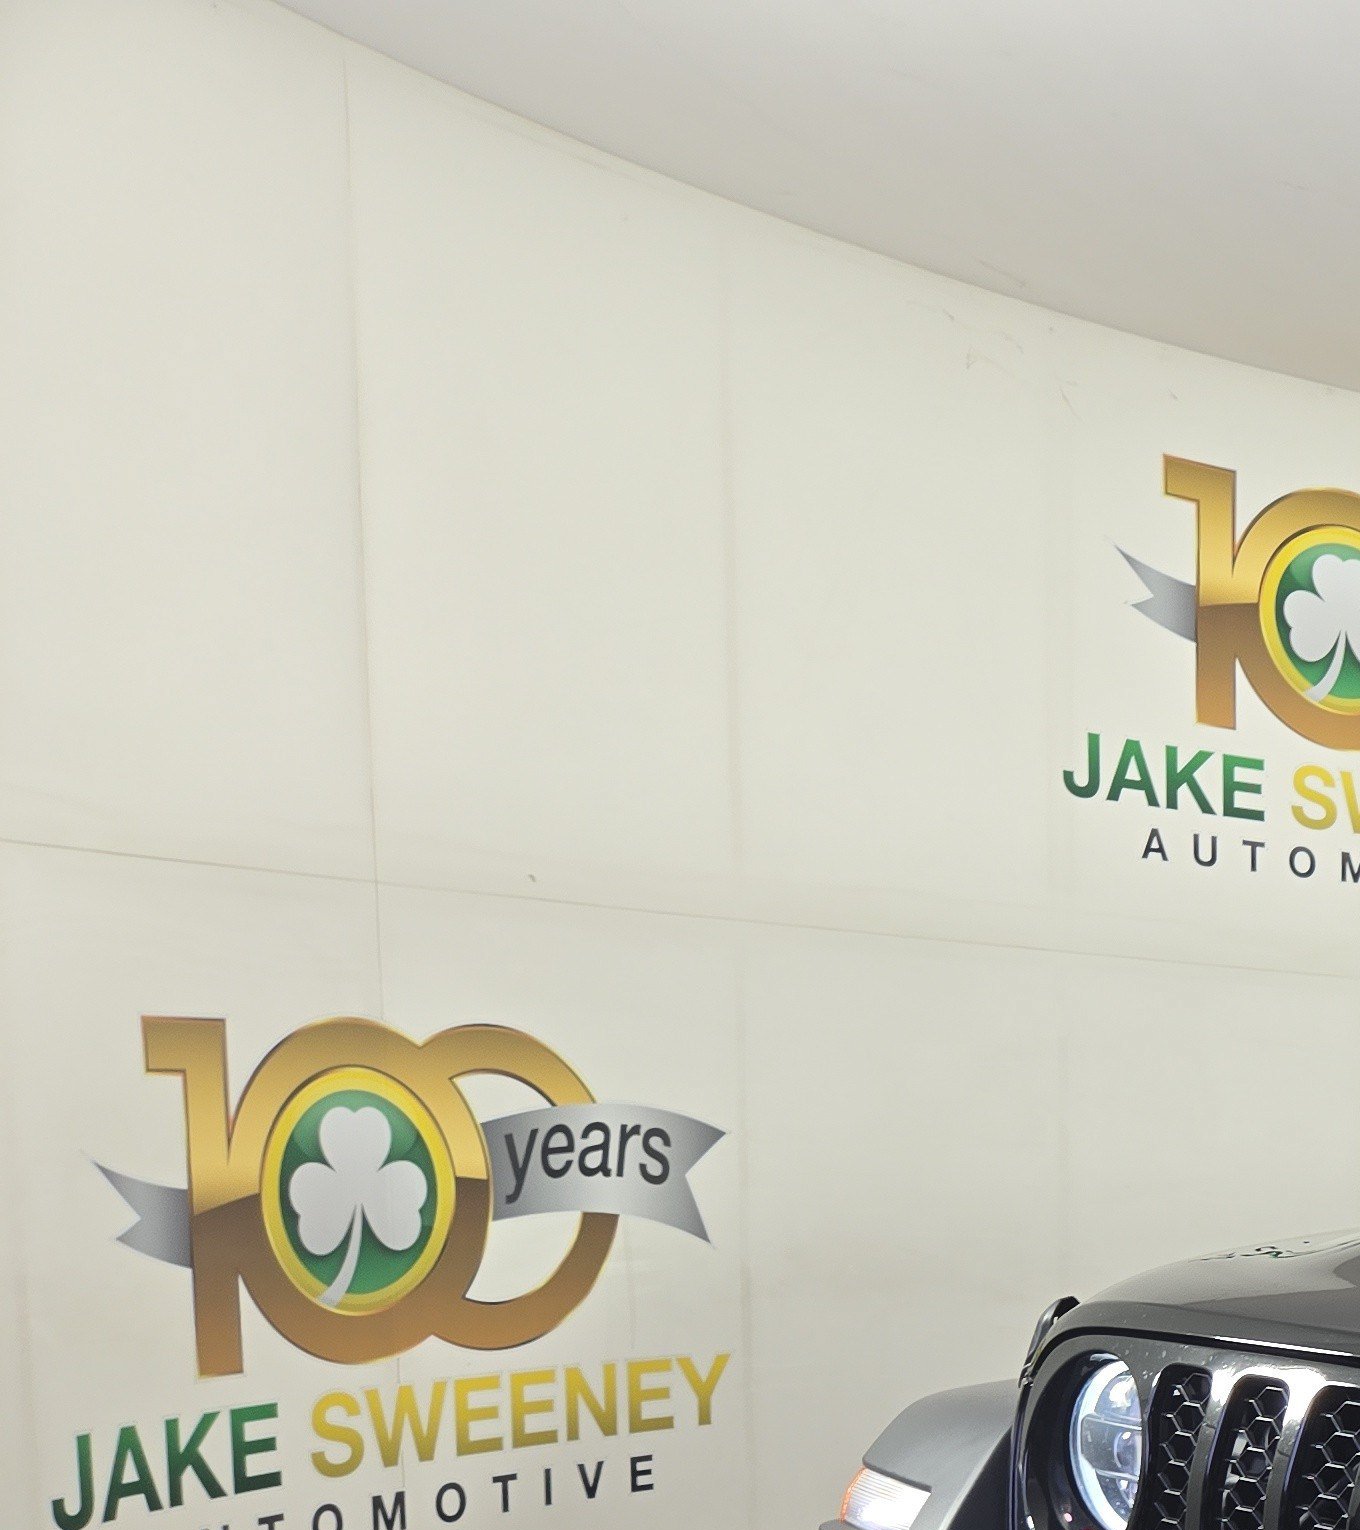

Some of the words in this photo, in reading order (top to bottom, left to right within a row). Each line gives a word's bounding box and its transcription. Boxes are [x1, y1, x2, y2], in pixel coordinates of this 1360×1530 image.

[1062, 732, 1266, 822] JAKE
[140, 1015, 622, 1380] 100
[504, 1121, 672, 1201] years
[310, 1353, 732, 1479] SWEENEY
